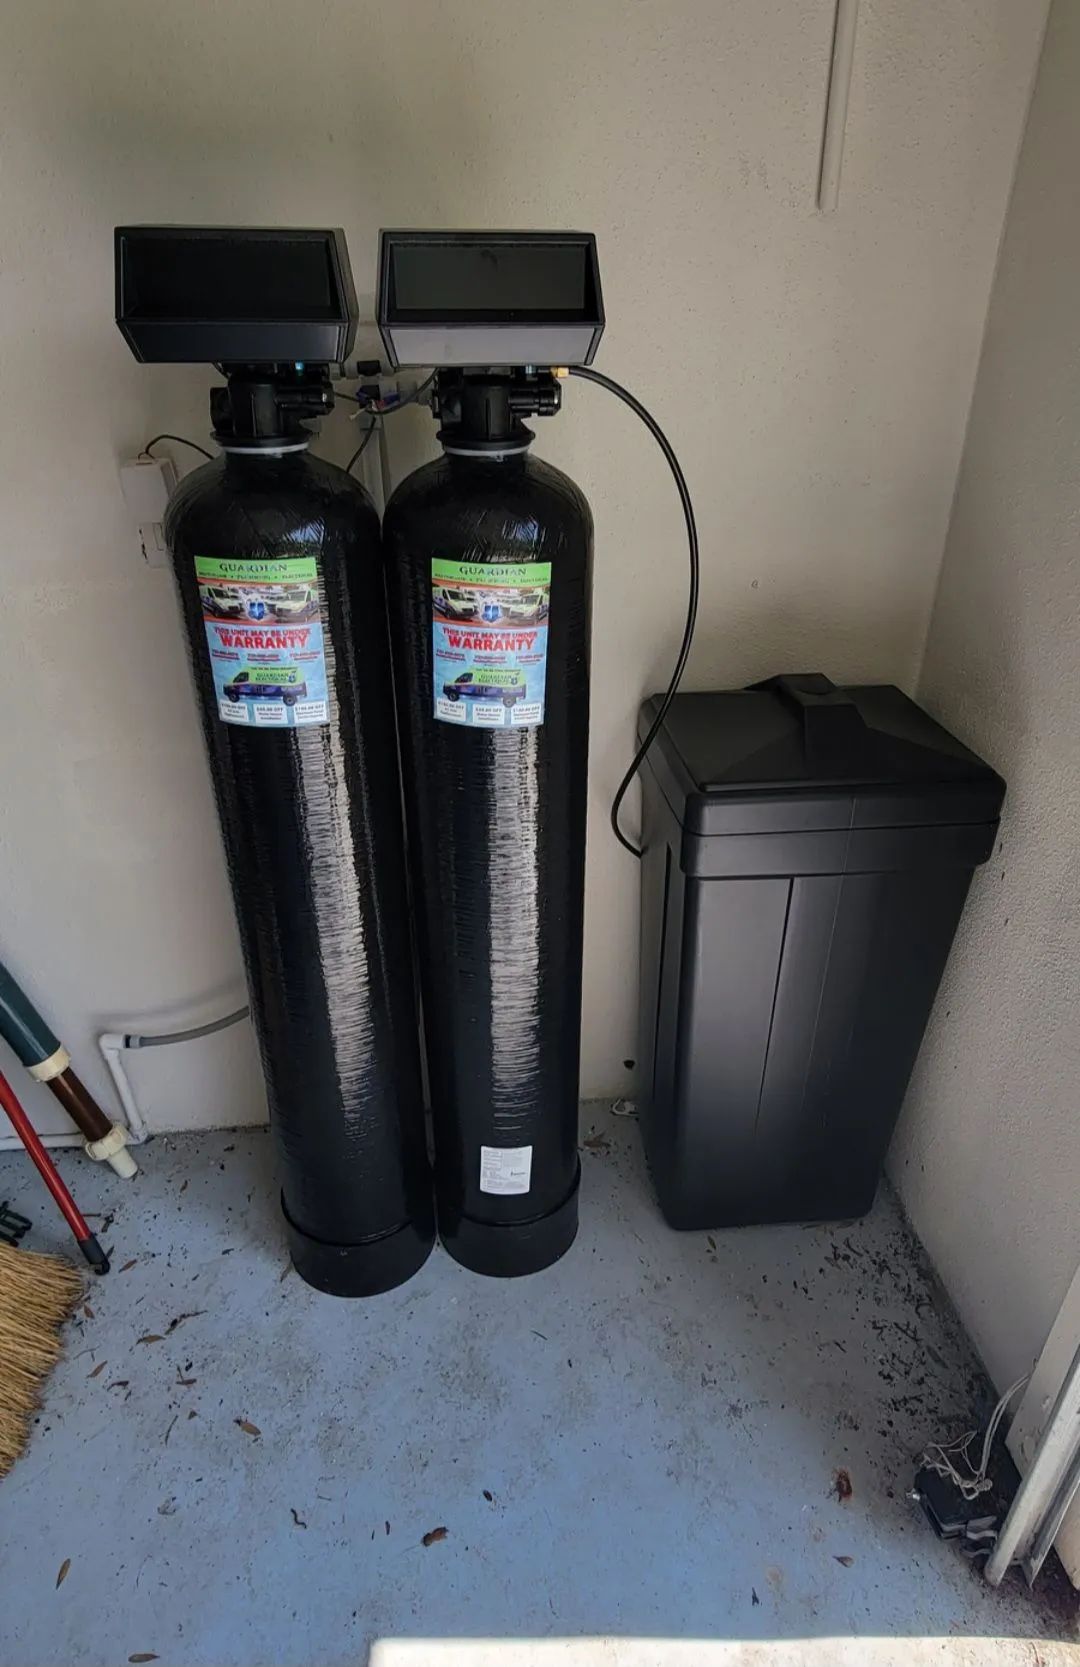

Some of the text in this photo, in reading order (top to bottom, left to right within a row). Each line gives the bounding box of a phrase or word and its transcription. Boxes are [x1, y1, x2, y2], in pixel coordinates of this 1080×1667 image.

[219, 563, 288, 573] GUARDIAN
[459, 566, 527, 576] GUARDIAN
[250, 629, 270, 638] MAY
[442, 627, 460, 636] THIS
[461, 629, 480, 638] UNIT
[481, 631, 500, 640] MAY
[514, 631, 539, 640] UNDER
[219, 634, 310, 649] WARRANTY
[448, 635, 534, 652] WARRANTY
